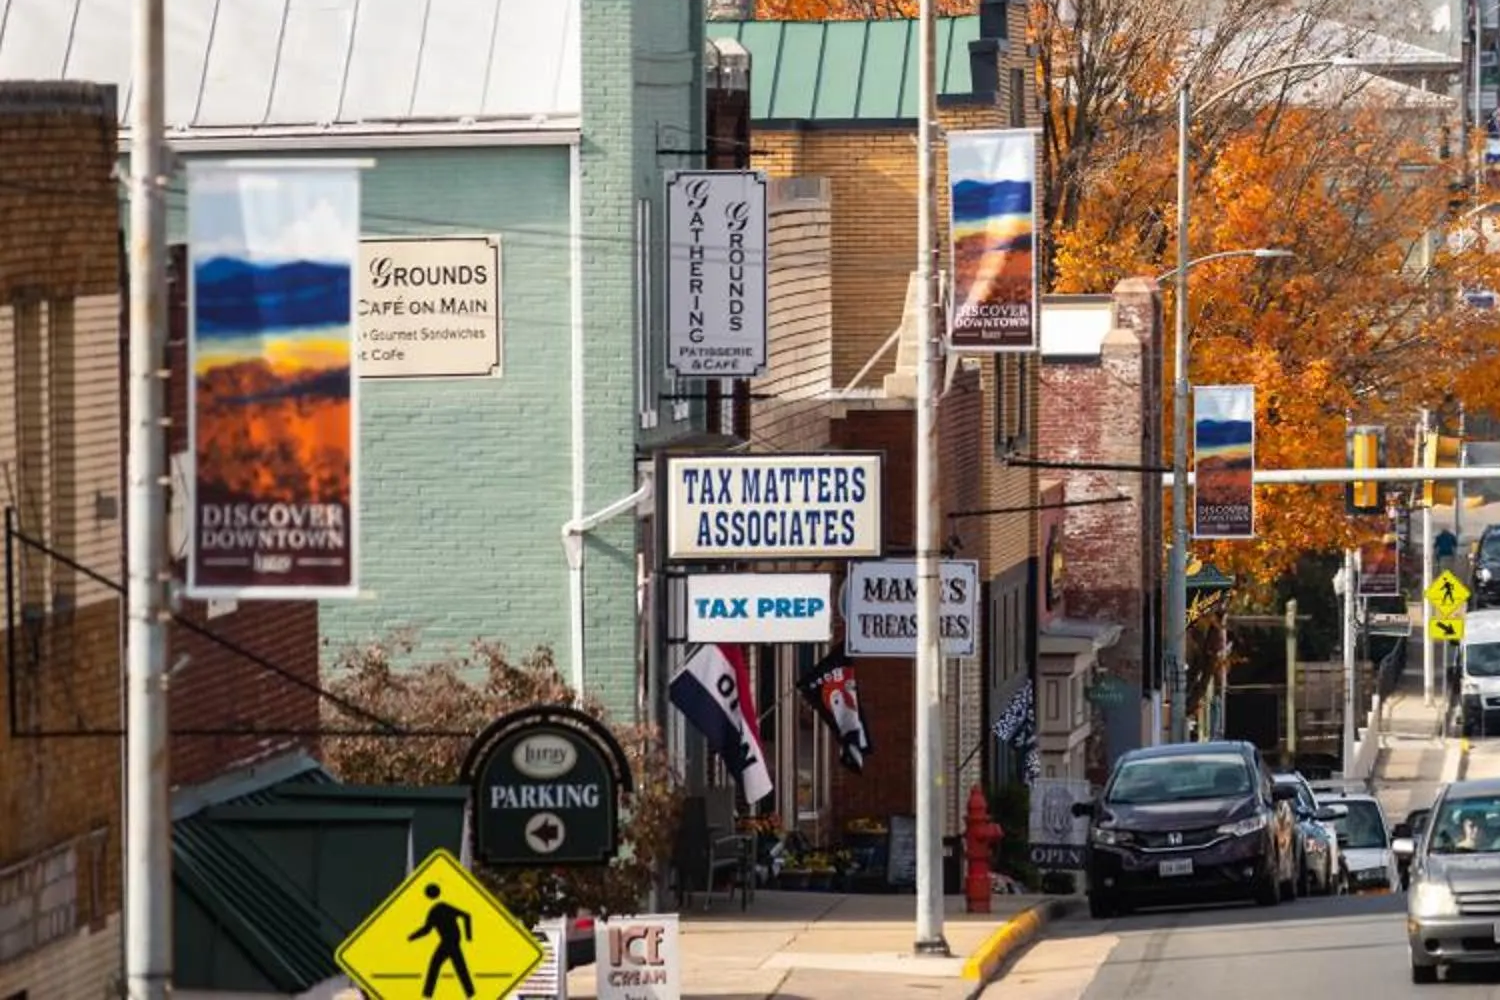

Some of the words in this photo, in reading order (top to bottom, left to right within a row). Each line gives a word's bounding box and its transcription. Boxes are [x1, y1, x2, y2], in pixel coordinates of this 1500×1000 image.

[369, 256, 488, 288] GROUNDS
[685, 178, 710, 343] GATHERING
[725, 200, 750, 332] GROUNDS
[409, 301, 435, 315] ON
[440, 297, 487, 314] MAIN
[682, 467, 732, 505] TAX
[742, 466, 866, 504] MATTERS
[203, 503, 344, 528] DISCOVER
[696, 509, 856, 547] ASSOCIATES
[202, 528, 344, 549] DOWNTOWN
[863, 577, 967, 604] MAM'S
[694, 598, 749, 619] TAX
[757, 597, 825, 618] PREP
[858, 613, 970, 639] TREASES
[490, 783, 600, 809] PARKING
[1030, 850, 1080, 864] OPEN
[608, 924, 665, 967] ICE
[607, 969, 667, 987] CREAM
